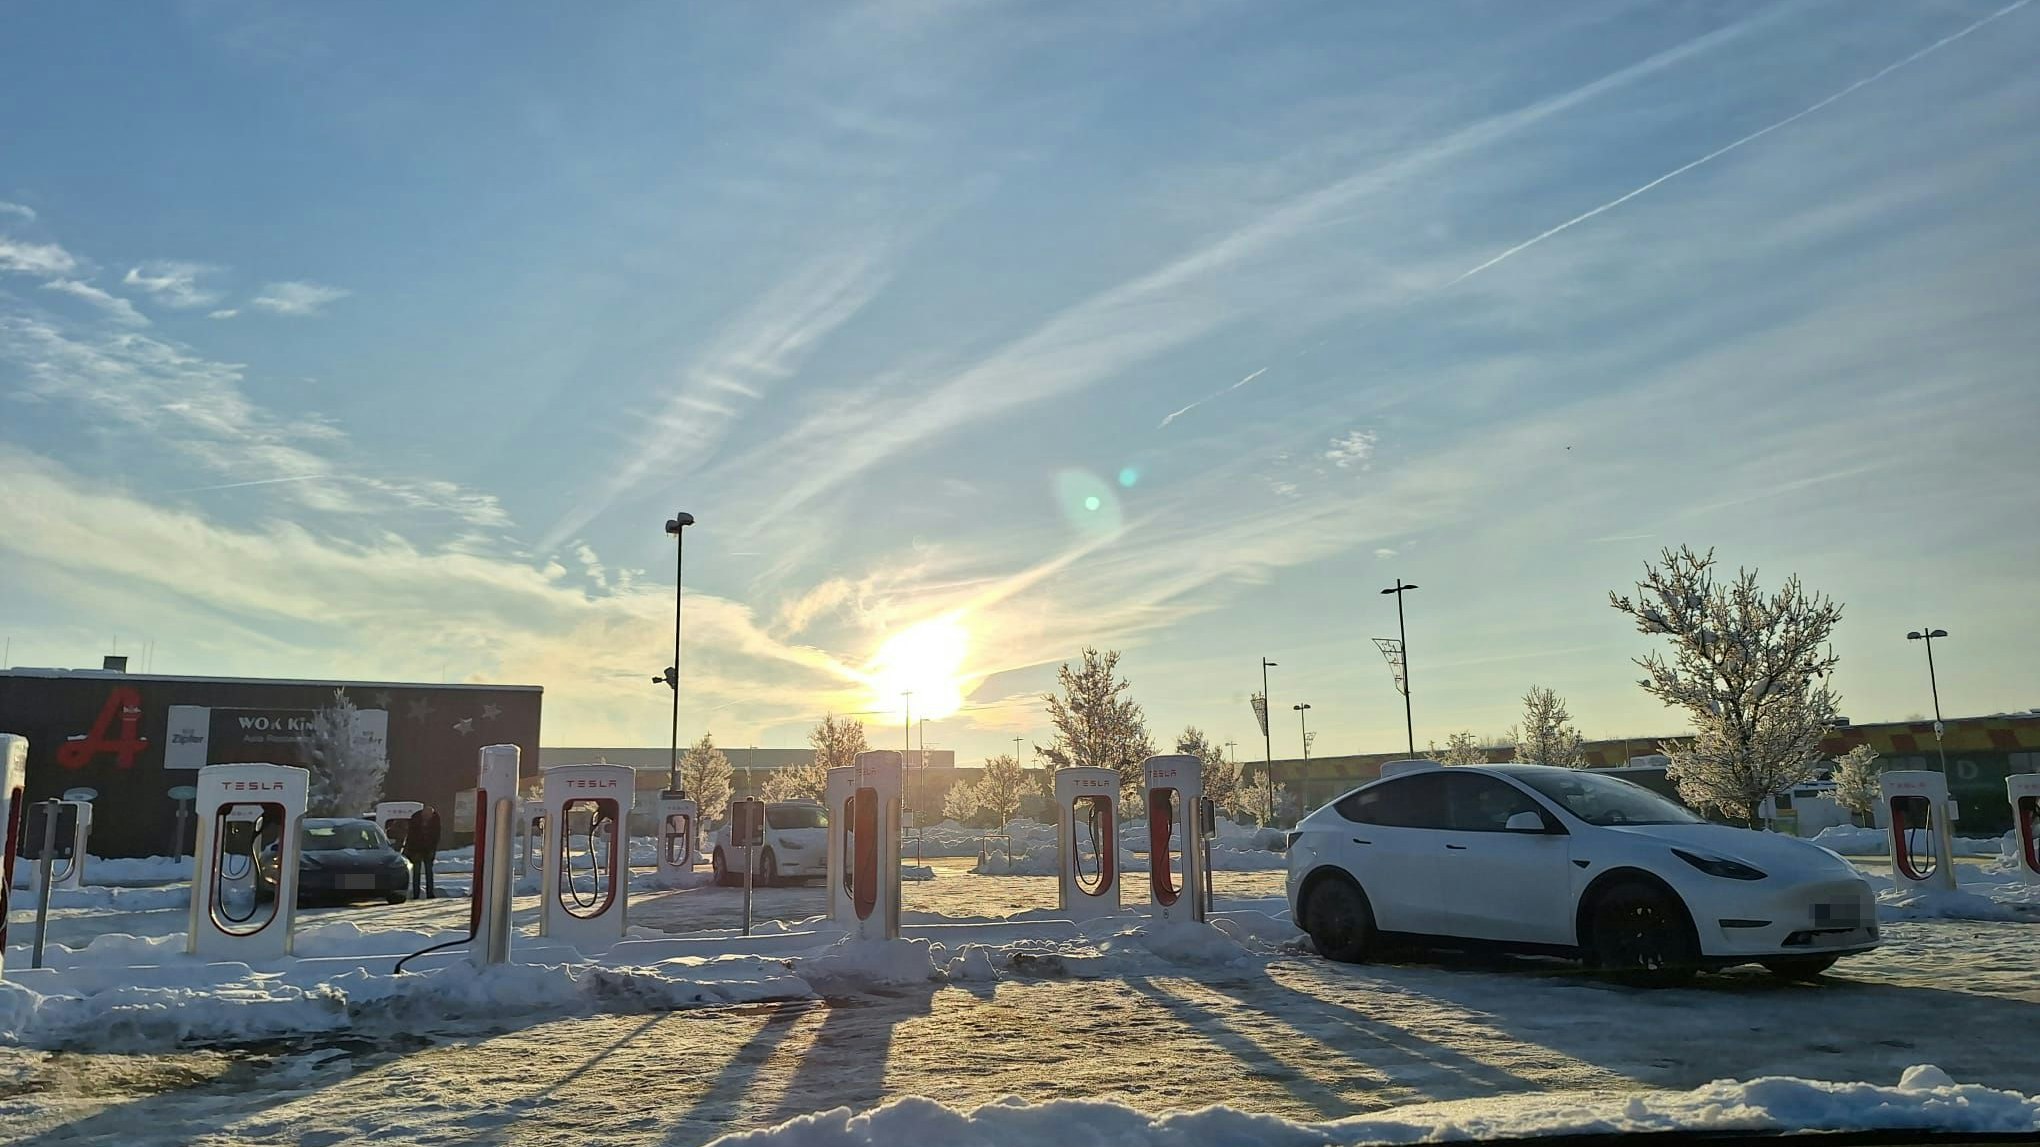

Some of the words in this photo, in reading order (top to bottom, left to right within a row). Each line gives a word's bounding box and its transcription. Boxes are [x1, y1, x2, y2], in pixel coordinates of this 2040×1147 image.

[239, 717, 282, 730] WOK
[288, 717, 323, 731] Kin
[1148, 769, 1177, 778] TESLA
[221, 781, 284, 791] TESLA
[566, 780, 617, 788] TESLA
[1072, 779, 1110, 787] TESLA
